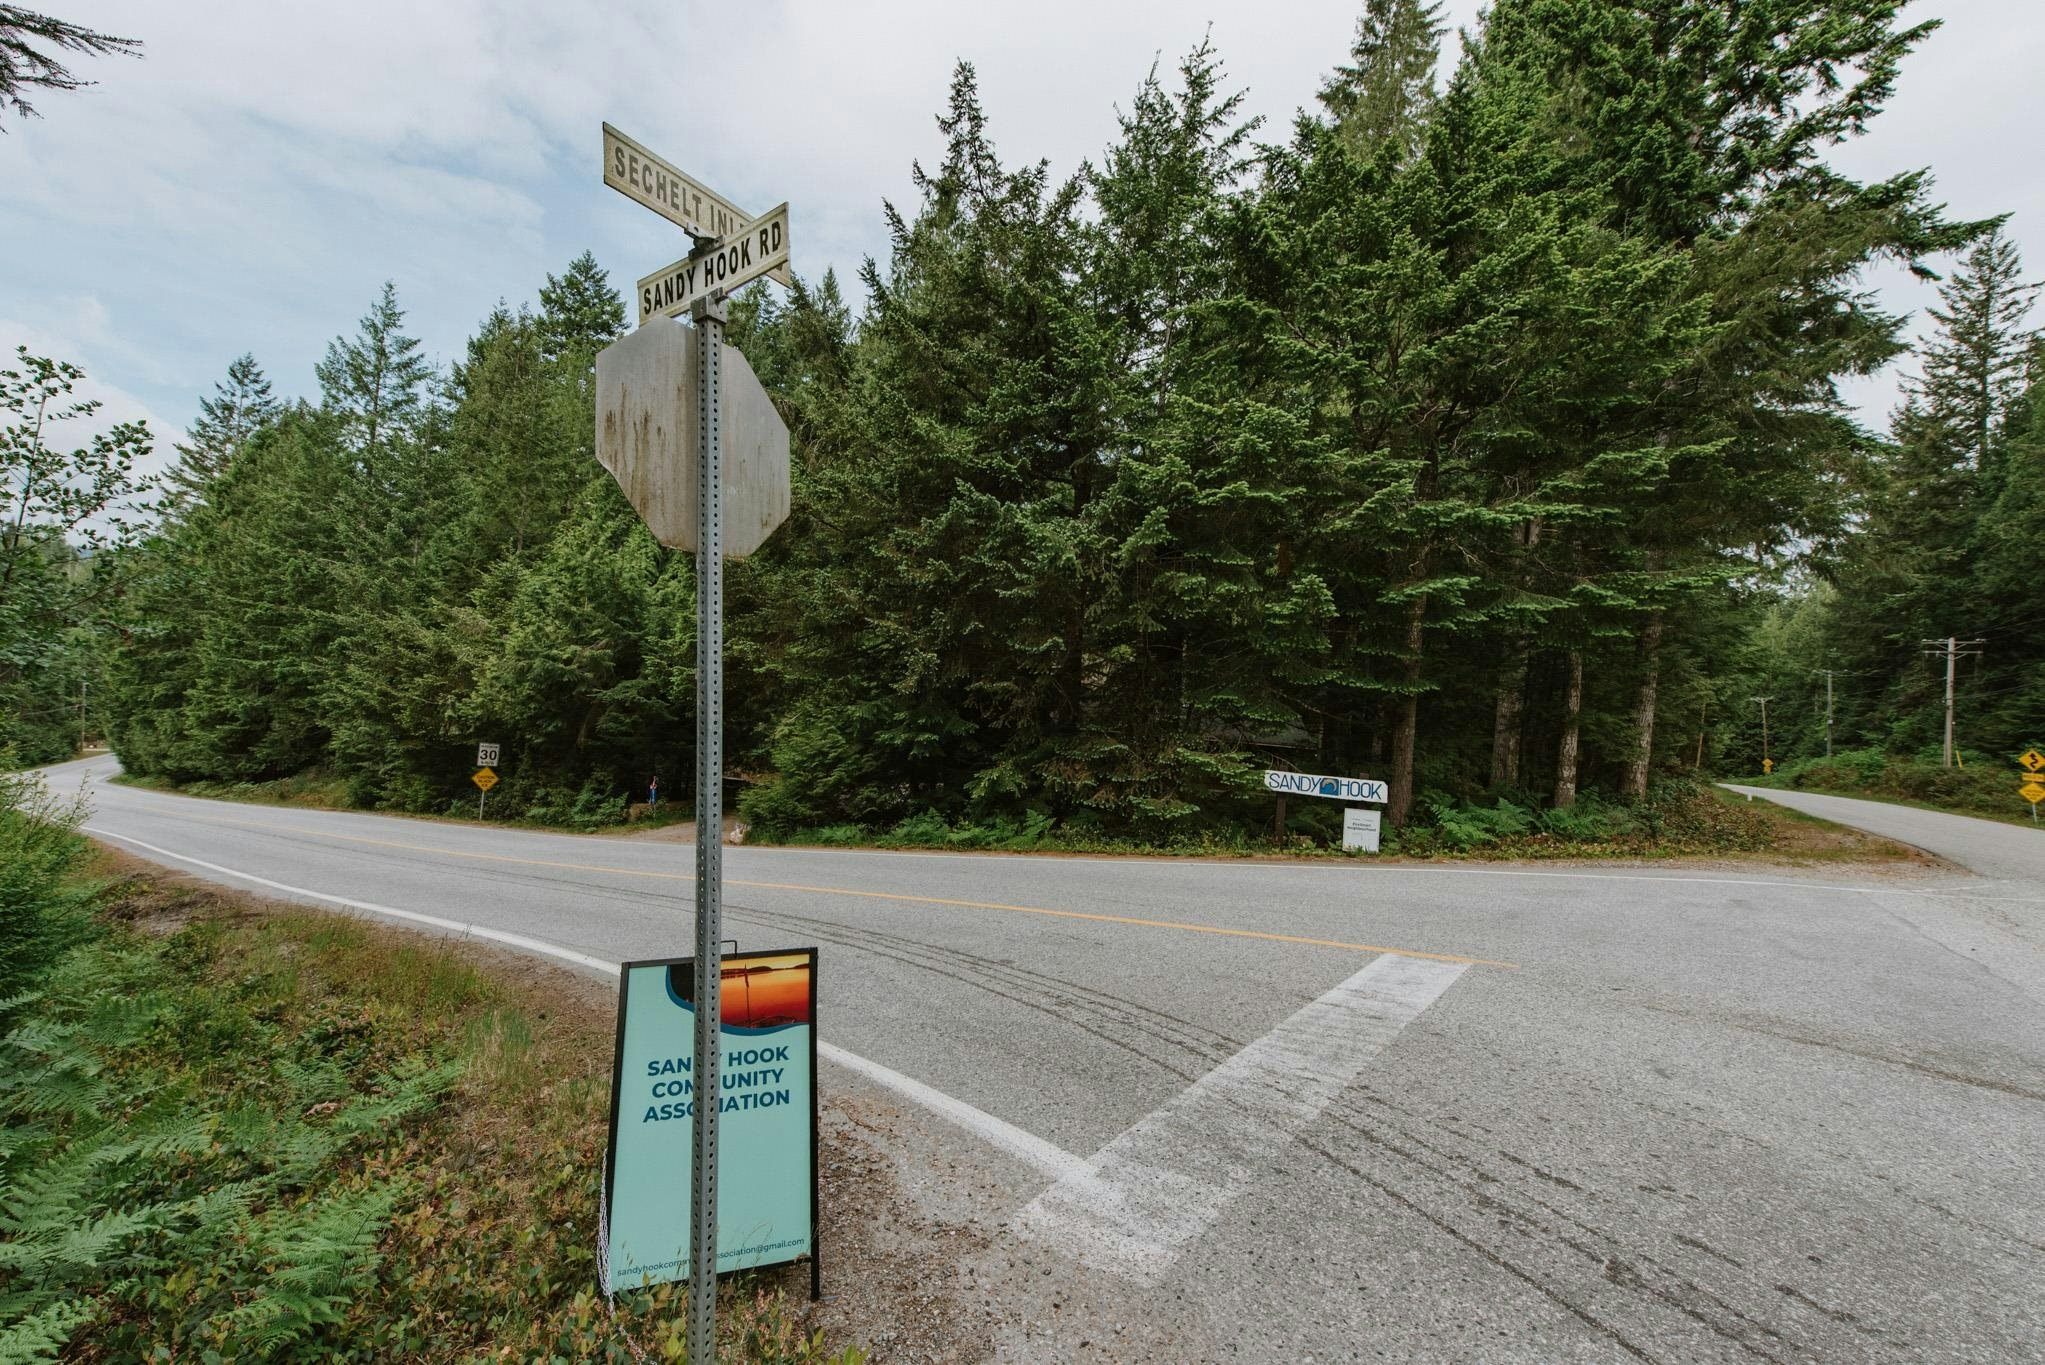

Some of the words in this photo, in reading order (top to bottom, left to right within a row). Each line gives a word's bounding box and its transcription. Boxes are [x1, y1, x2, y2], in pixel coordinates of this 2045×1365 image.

[614, 146, 702, 223] SECHELT
[644, 266, 696, 315] SANDY
[704, 237, 751, 288] HOOK
[760, 221, 781, 259] RD
[480, 749, 497, 760] 30
[1269, 773, 1321, 792] SANDY
[1340, 780, 1382, 800] HOOK
[647, 1053, 723, 1077] SAN
[728, 1045, 790, 1067] HOOK
